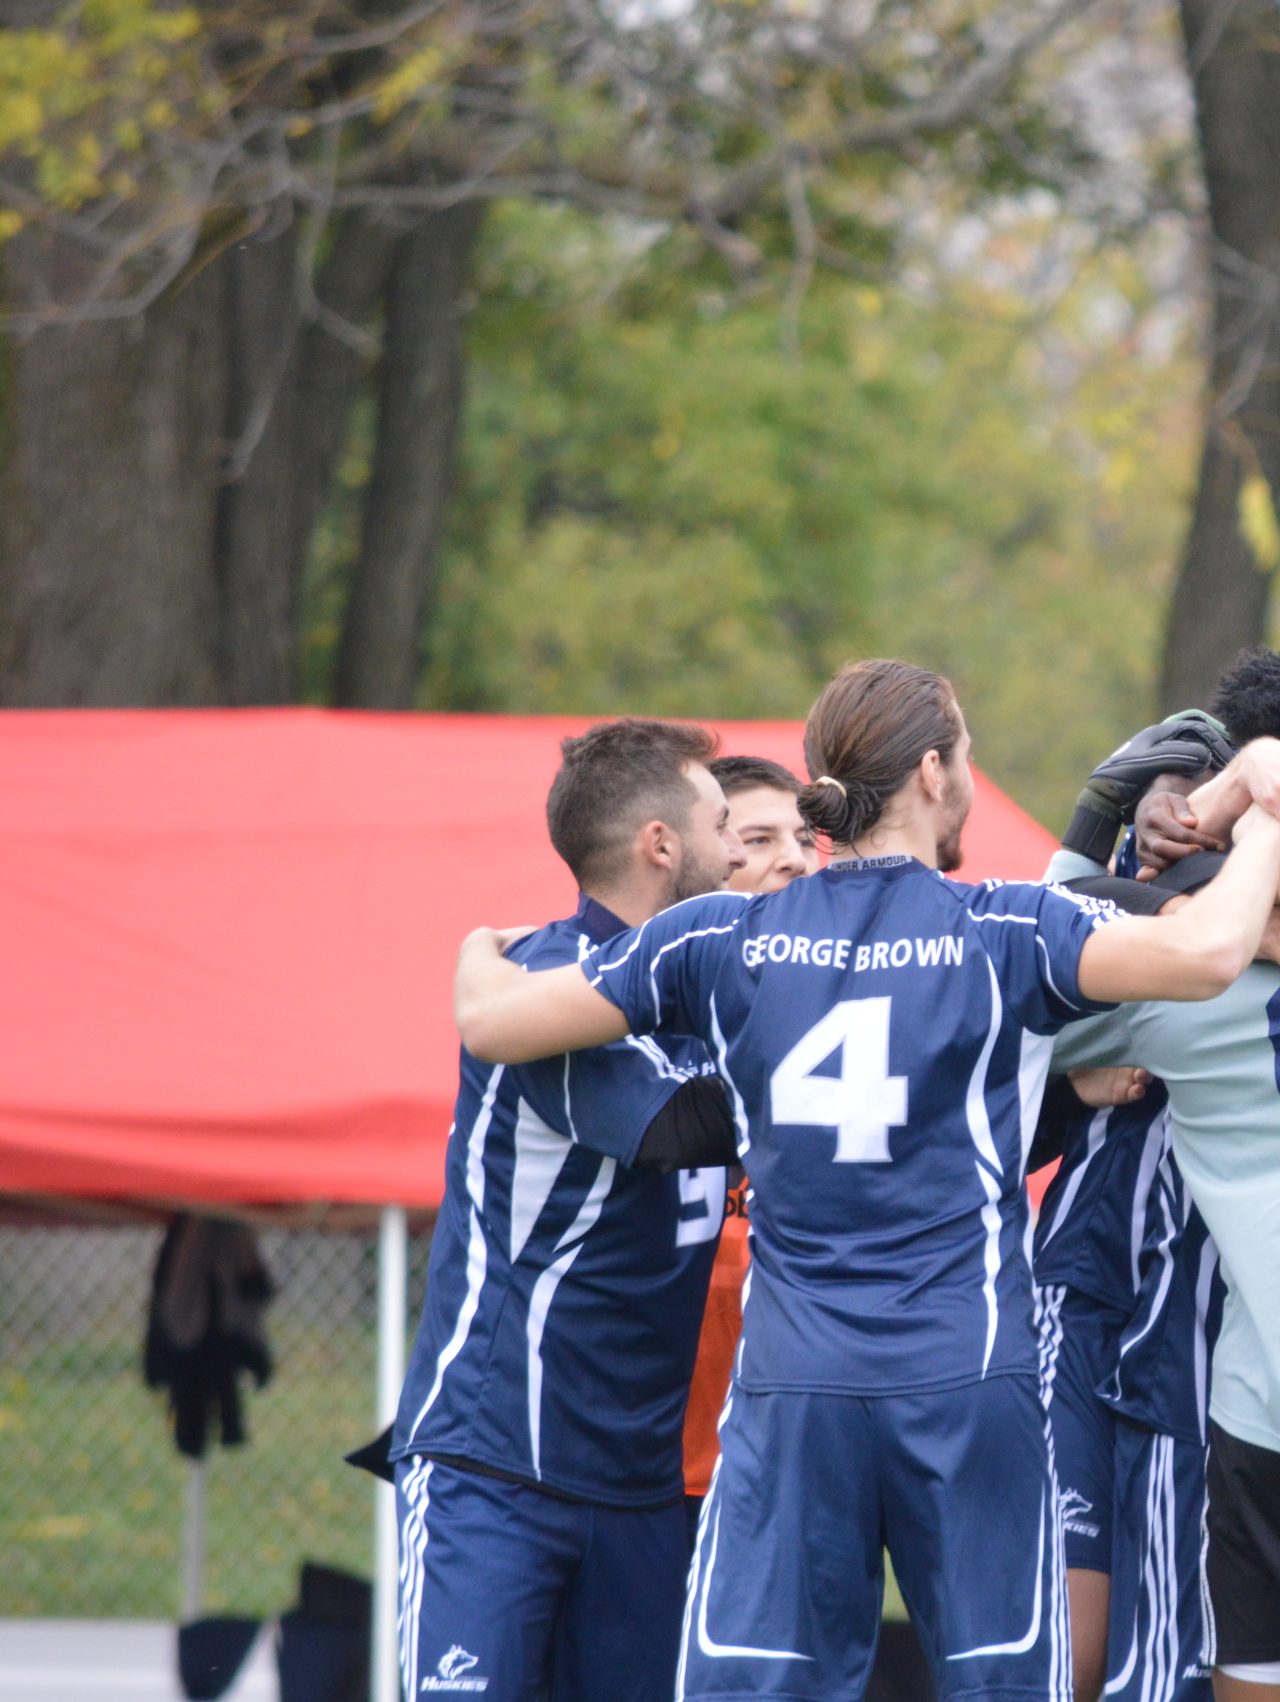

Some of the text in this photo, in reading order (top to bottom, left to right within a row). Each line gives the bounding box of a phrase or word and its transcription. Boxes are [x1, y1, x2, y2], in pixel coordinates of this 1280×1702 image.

[831, 855, 908, 873] UNDER ARMOUR
[742, 933, 964, 973] GEORGE BROWN
[770, 995, 909, 1163] 4
